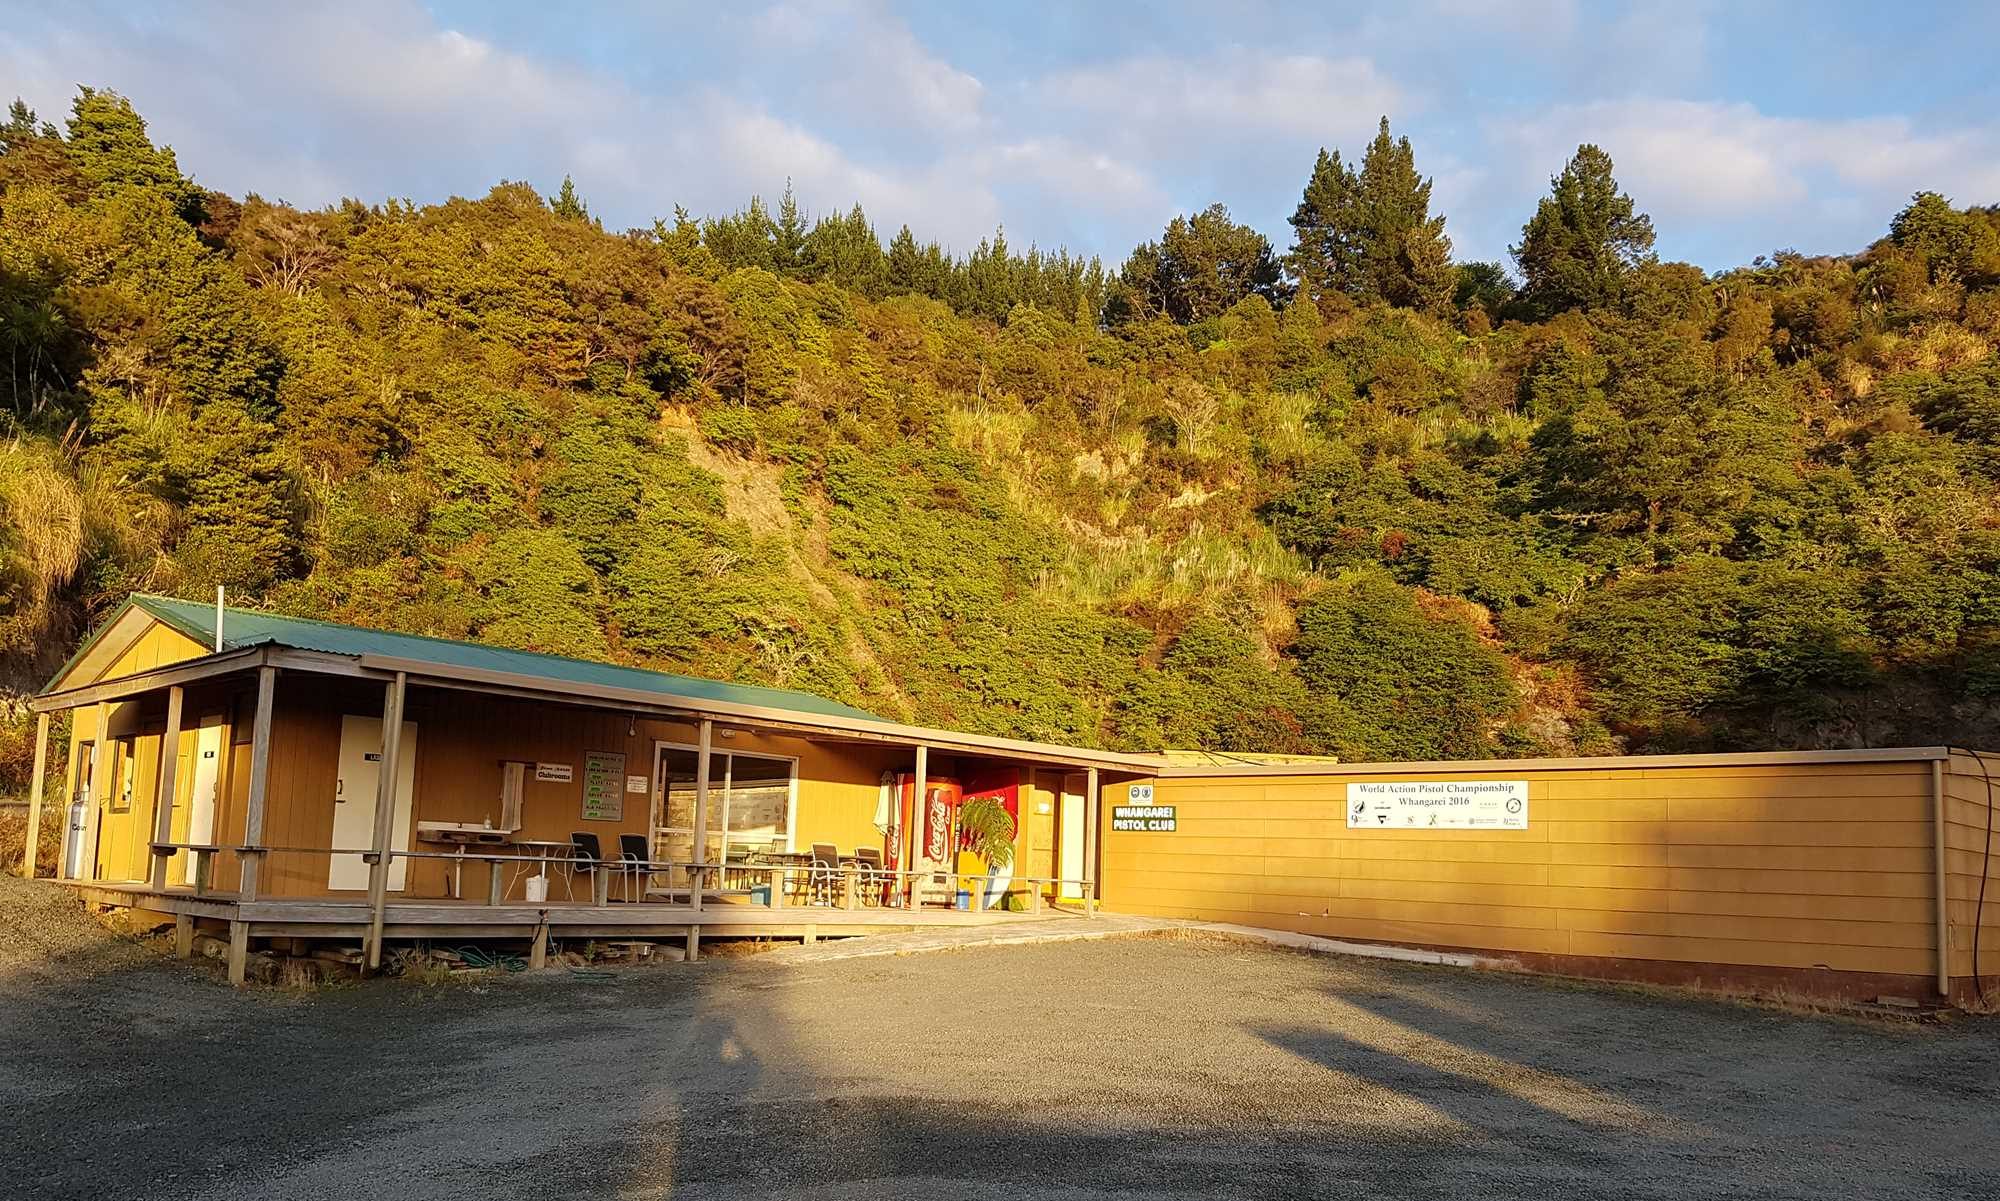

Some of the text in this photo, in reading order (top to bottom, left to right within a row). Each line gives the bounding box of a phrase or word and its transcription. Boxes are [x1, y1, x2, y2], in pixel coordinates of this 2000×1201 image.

[1359, 783, 1515, 795] World Action Pistol Championship
[1398, 797, 1446, 807] Whangarei
[1448, 797, 1470, 806] 2016
[1115, 807, 1173, 818] WHANGAREI
[1113, 819, 1175, 831] PISTOL CLUB
